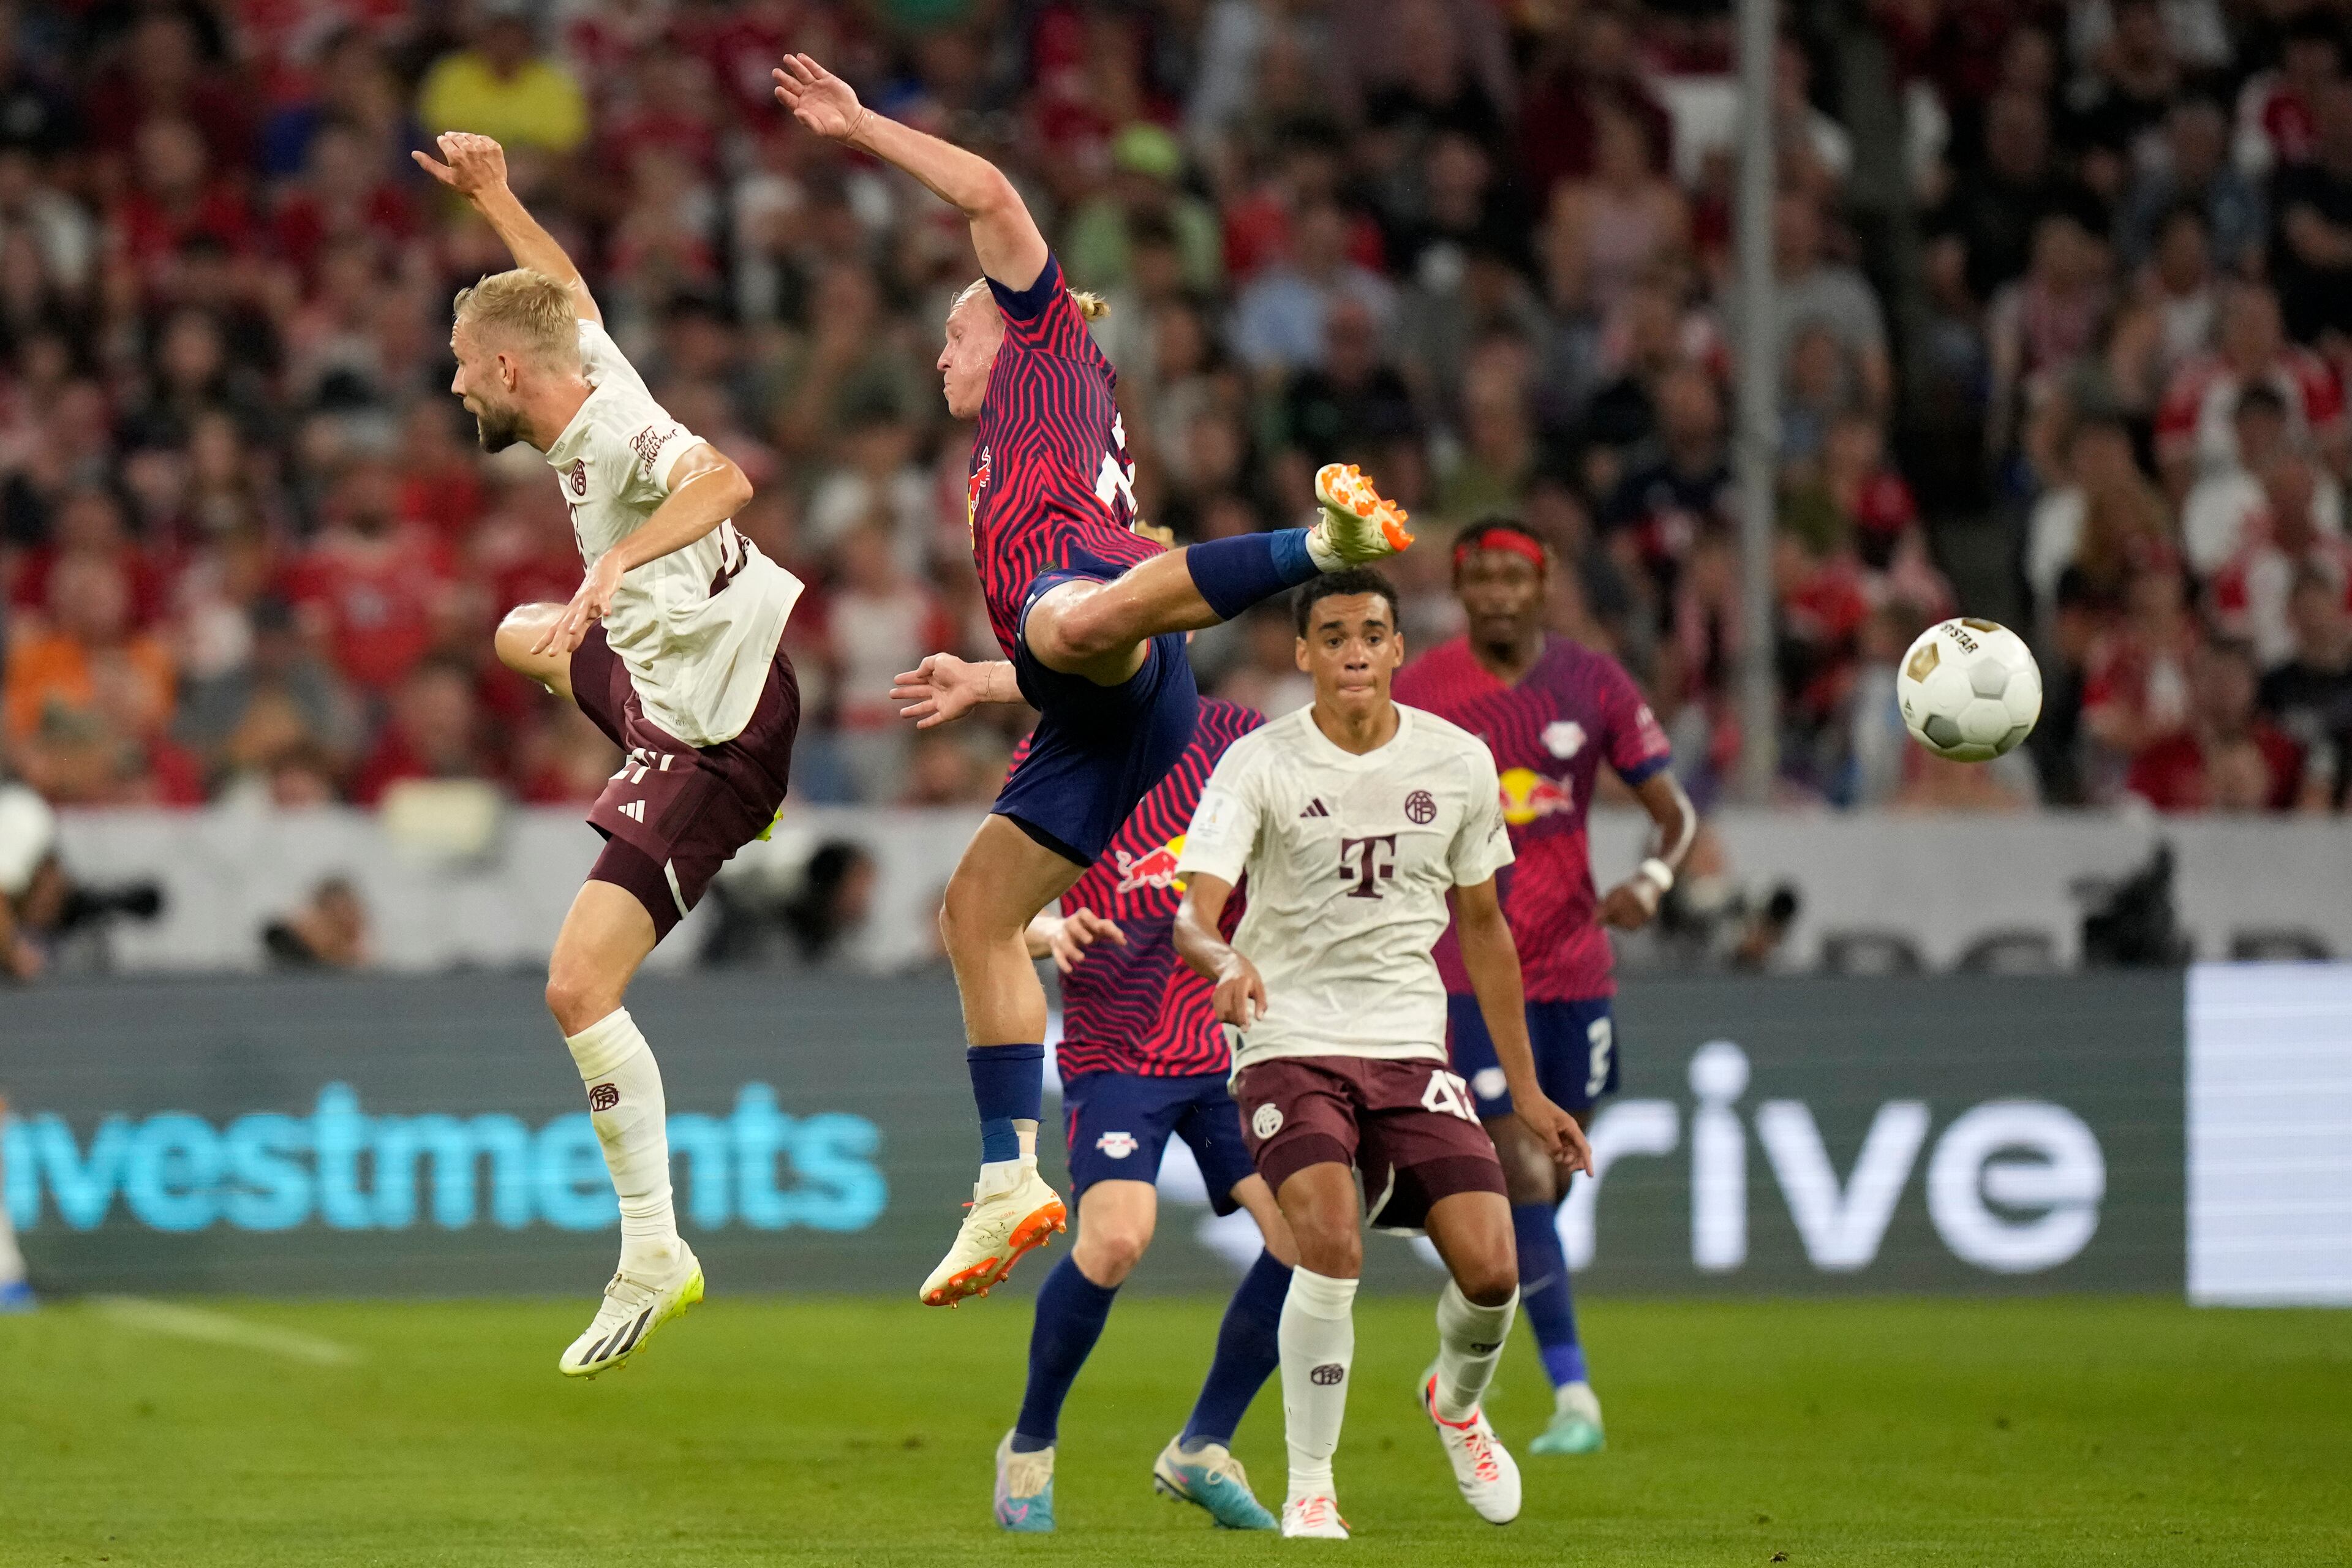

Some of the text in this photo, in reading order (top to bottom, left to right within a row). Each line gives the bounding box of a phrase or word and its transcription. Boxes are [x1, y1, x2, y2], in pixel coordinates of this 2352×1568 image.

[629, 426, 652, 453] ROT
[638, 430, 658, 461] GEGEN
[1409, 1039, 2107, 1275] rive
